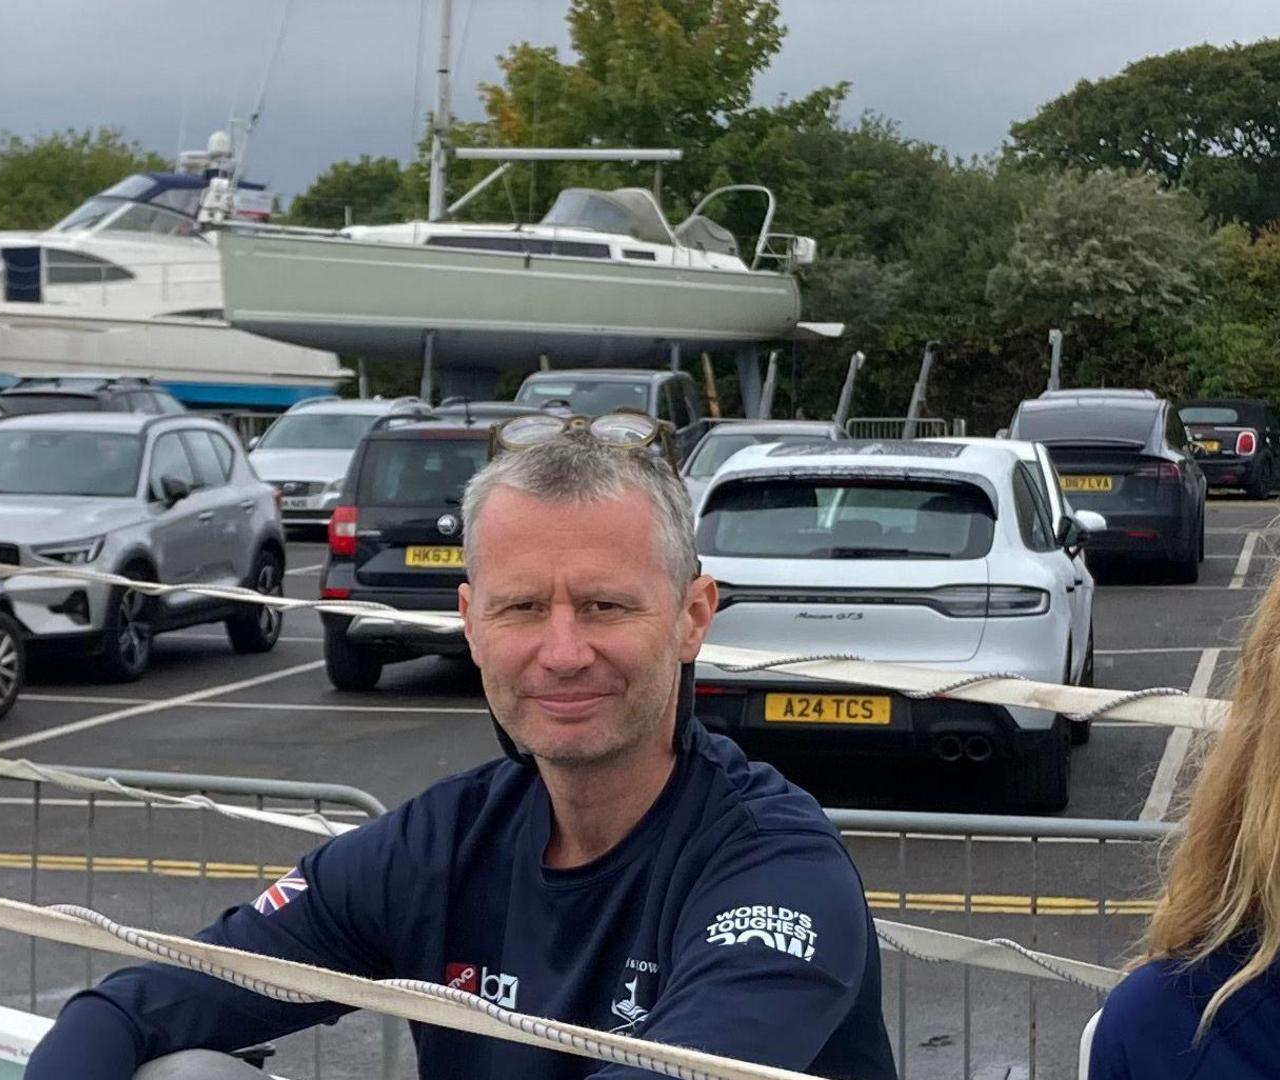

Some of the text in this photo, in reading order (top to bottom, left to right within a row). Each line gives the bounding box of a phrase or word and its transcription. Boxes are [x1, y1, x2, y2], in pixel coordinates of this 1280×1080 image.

[783, 697, 874, 720] A24 TCS
[716, 905, 813, 929] WORLD'S
[706, 917, 818, 945] TOUGHEST
